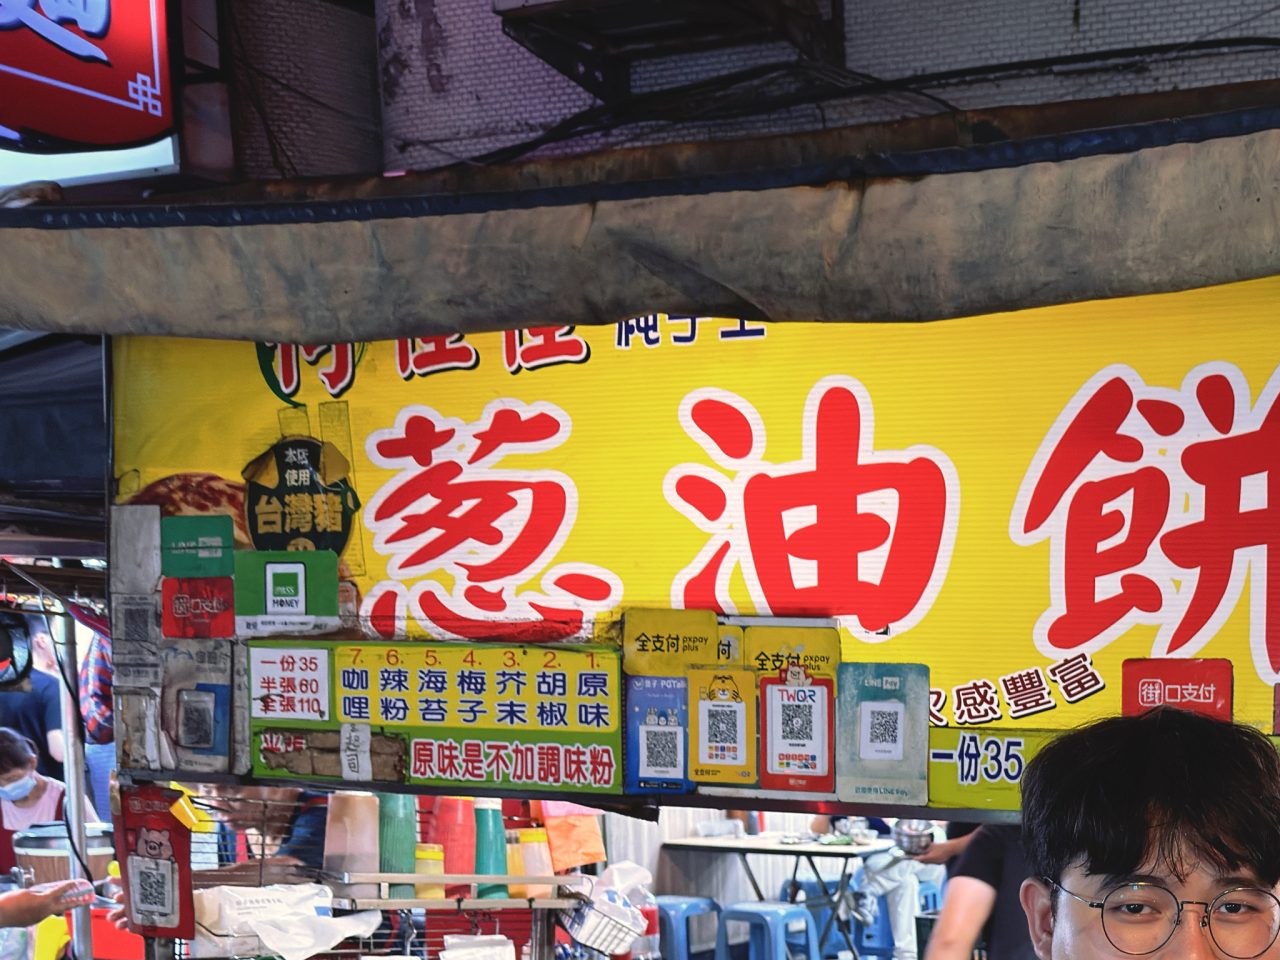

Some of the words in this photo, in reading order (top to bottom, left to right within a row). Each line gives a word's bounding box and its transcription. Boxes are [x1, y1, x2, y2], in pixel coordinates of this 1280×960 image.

[284, 448, 308, 464] 本店
[285, 469, 311, 486] 使用
[255, 493, 342, 534] 台灣豬
[635, 632, 680, 653] 全支付
[682, 635, 709, 645] pxpay
[682, 643, 699, 652] plus
[803, 655, 830, 664] pxpay
[778, 689, 816, 703] TWQR
[1139, 679, 1216, 705] 街口支付
[411, 740, 614, 786] 原味是不加調味粉
[931, 735, 1023, 782] 一份35
